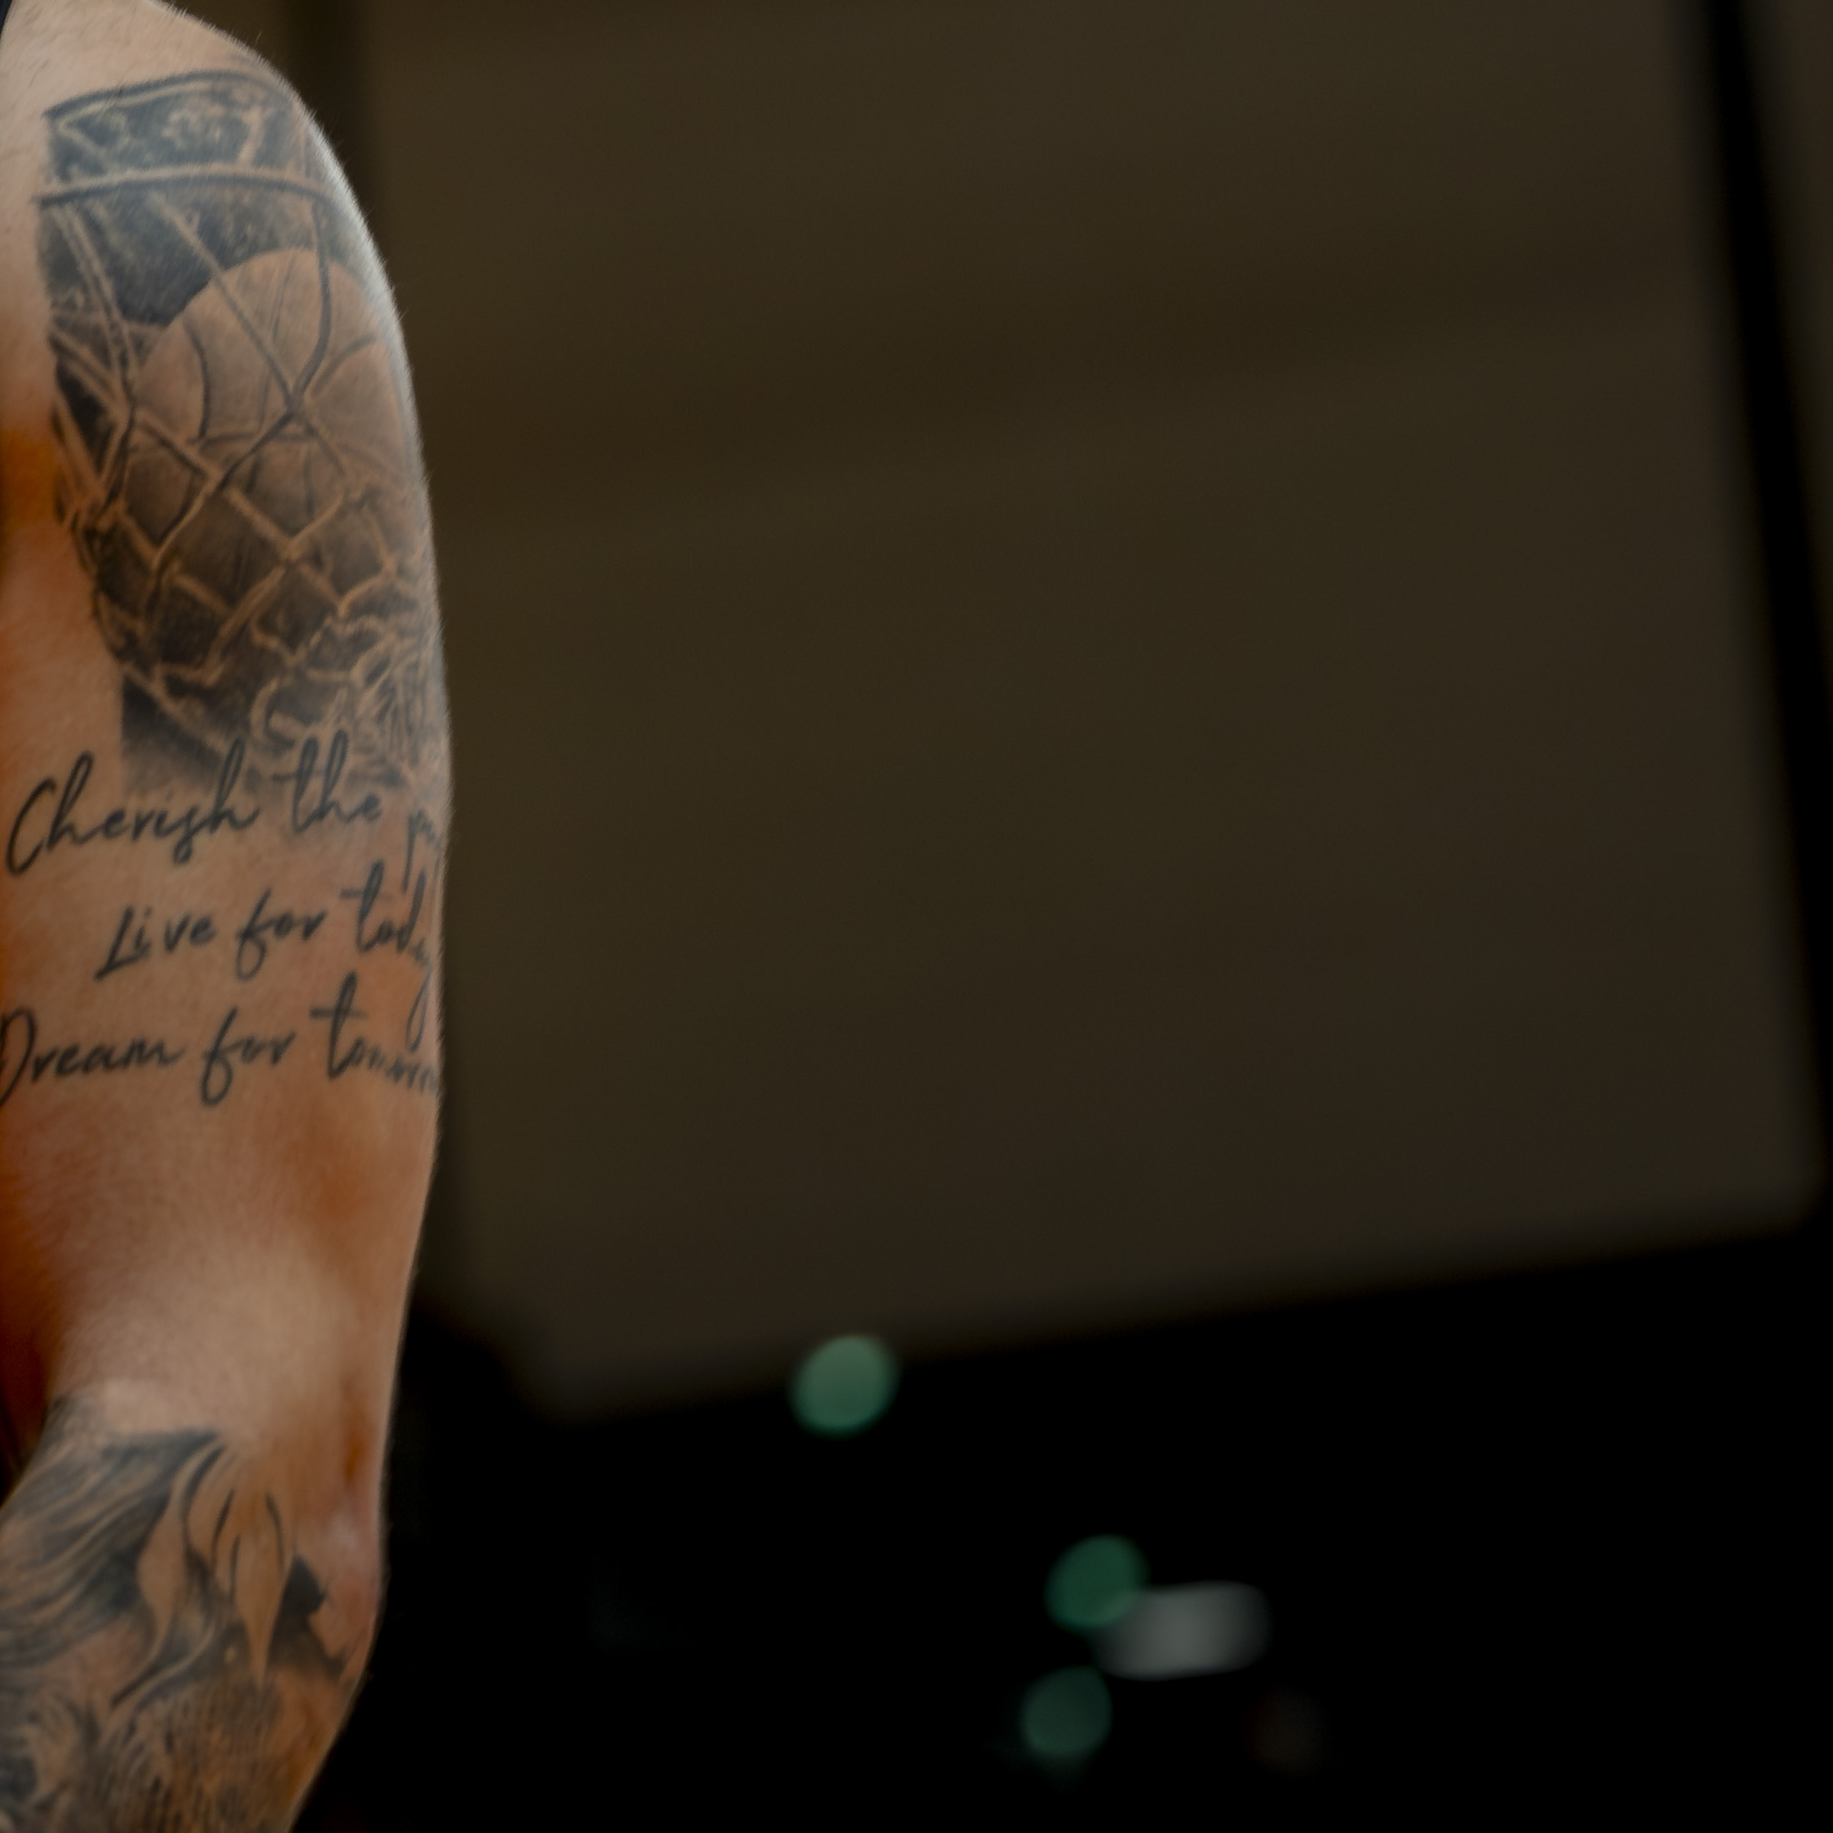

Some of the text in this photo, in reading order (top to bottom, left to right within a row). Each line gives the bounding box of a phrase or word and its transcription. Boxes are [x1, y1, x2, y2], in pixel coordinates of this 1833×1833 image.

[4, 737, 261, 877] Cherish
[272, 730, 382, 834] the
[93, 901, 218, 982] Live
[234, 889, 329, 982] for
[200, 1007, 298, 1107] for
